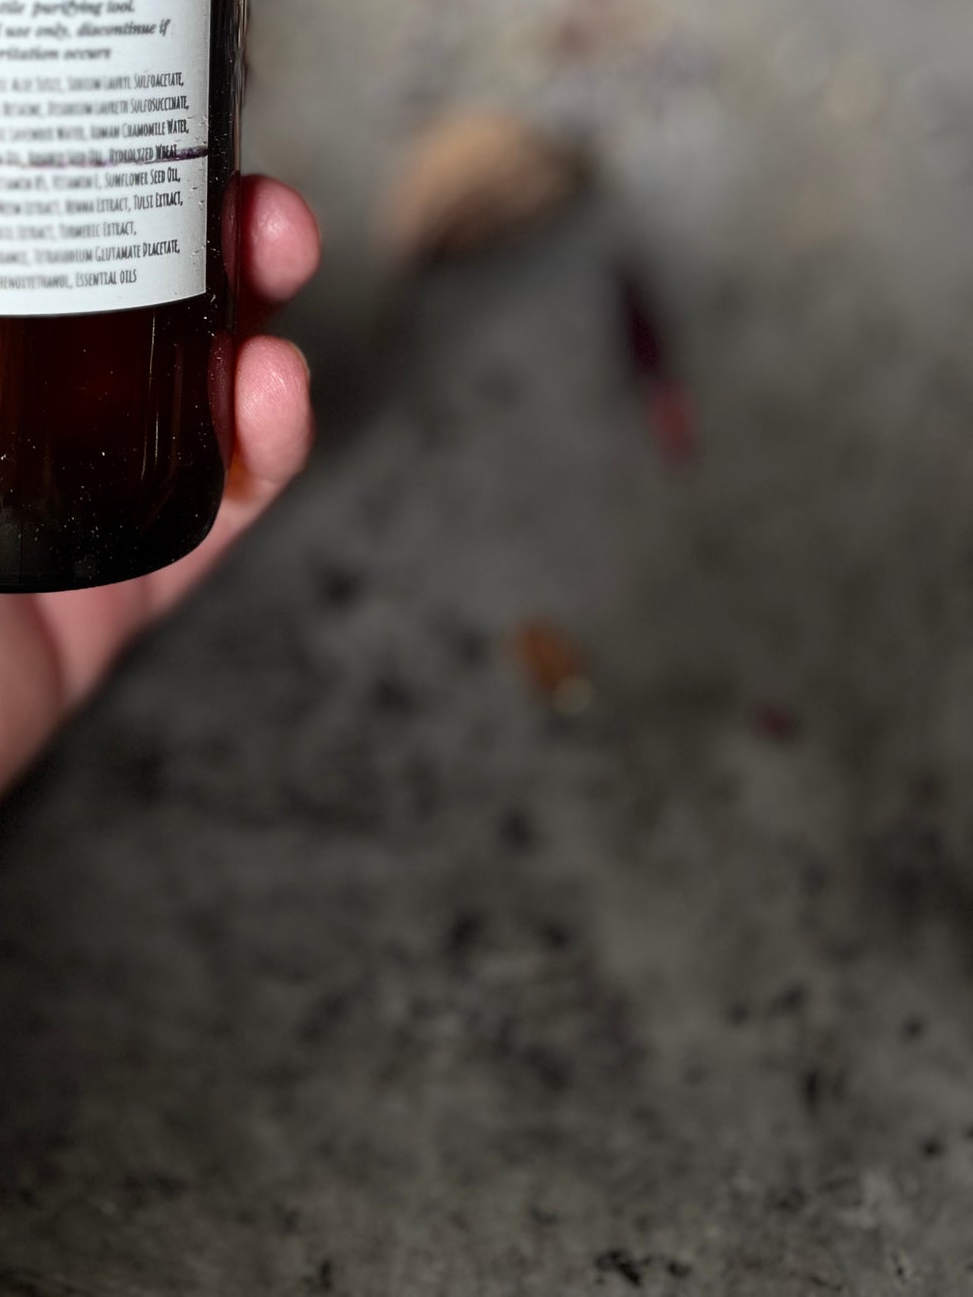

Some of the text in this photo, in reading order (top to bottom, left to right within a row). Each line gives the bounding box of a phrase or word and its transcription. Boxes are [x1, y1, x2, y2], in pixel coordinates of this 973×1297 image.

[5, 27, 30, 38] use
[75, 20, 157, 38] discontinue
[158, 18, 172, 36] if
[167, 118, 190, 135] WATER,
[149, 168, 166, 186] SEED
[155, 190, 184, 208] EXTRACT,
